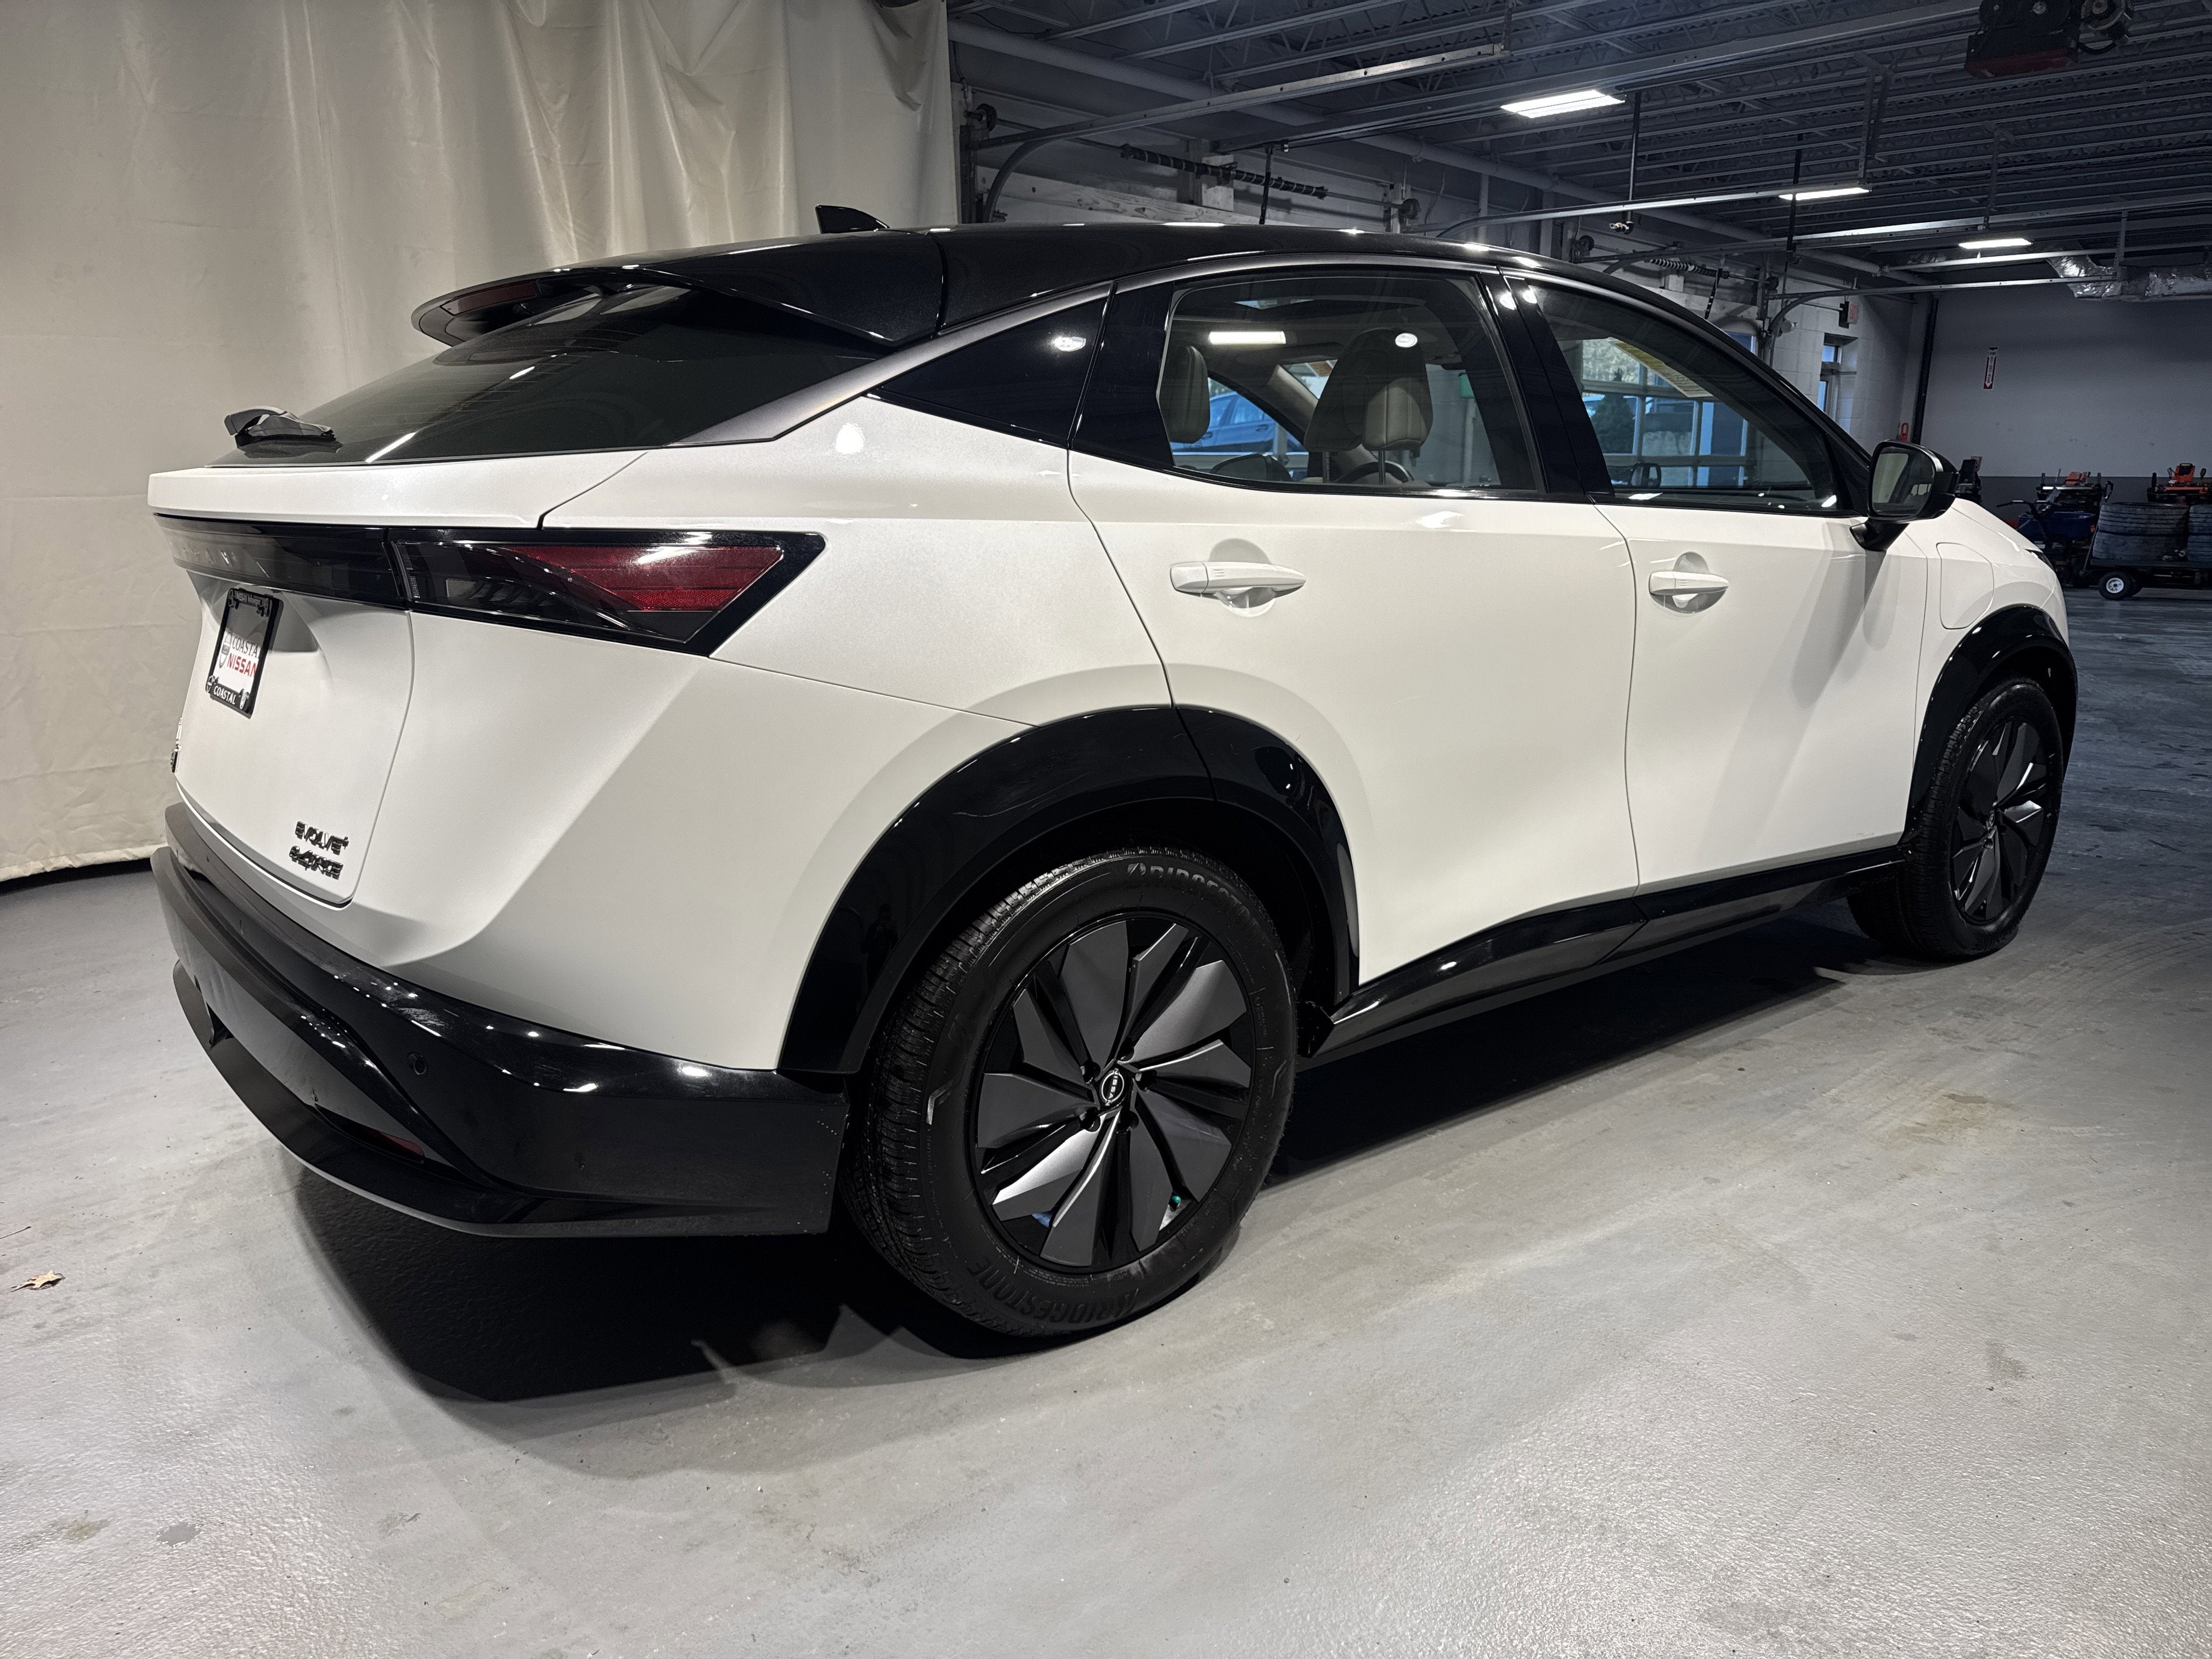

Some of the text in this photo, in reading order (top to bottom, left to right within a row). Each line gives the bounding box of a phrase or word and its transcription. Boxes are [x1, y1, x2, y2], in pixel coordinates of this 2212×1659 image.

[232, 636, 260, 658] COASTA
[227, 652, 257, 677] NISSAN
[213, 685, 236, 705] COASTAL
[1105, 1068, 1119, 1107] NISSAN
[967, 1261, 1139, 1324] BRIDGESTONE
